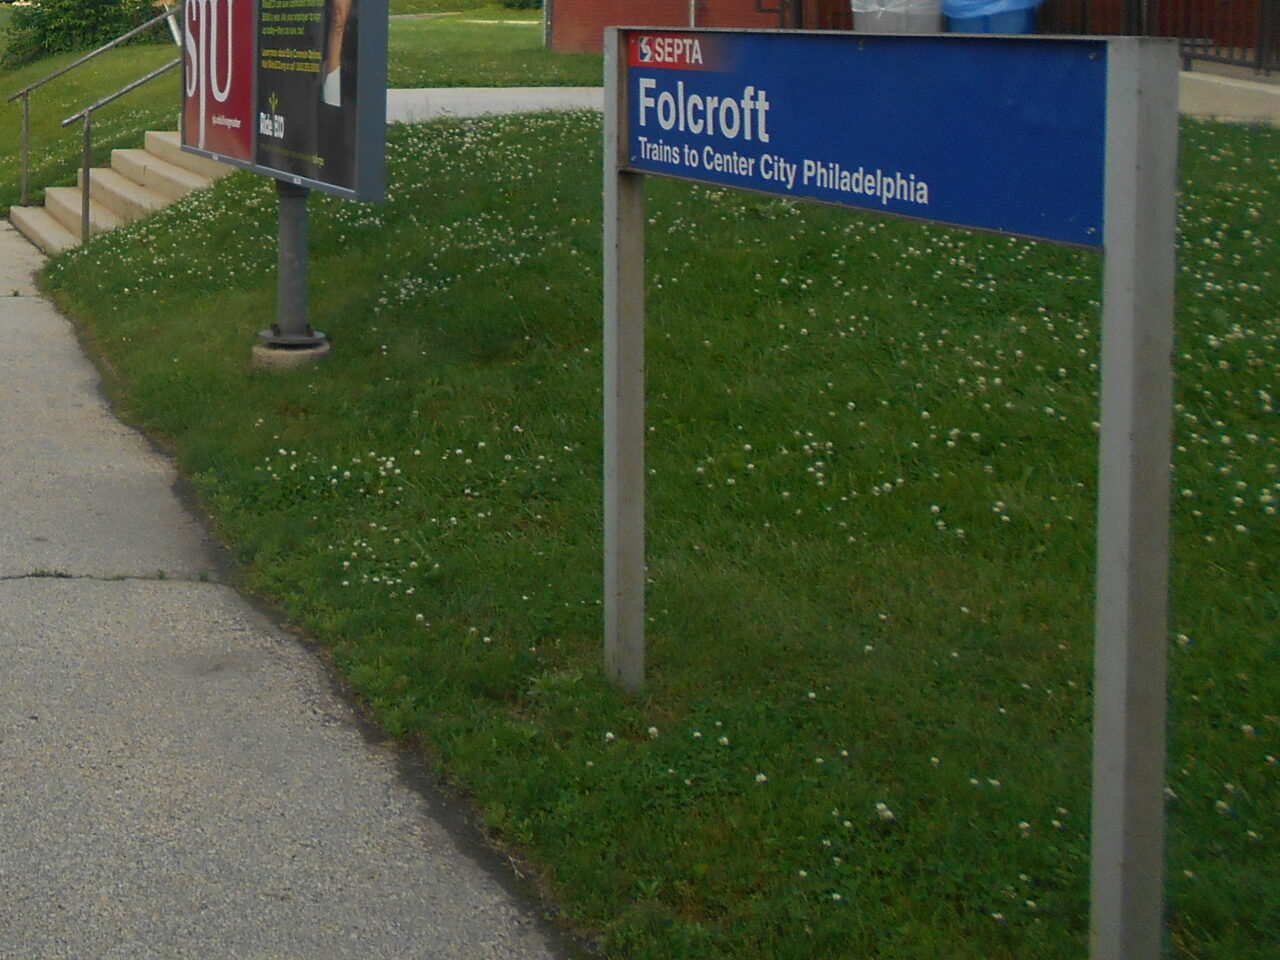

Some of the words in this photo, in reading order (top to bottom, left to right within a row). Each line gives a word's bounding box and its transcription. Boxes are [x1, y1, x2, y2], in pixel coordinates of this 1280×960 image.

[654, 37, 703, 65] SEPTA
[638, 77, 770, 143] Folcroft
[638, 136, 680, 165] Trains
[684, 144, 699, 168] to
[703, 145, 755, 177] Center
[760, 153, 797, 190] City
[803, 159, 929, 205] Philadelphia
